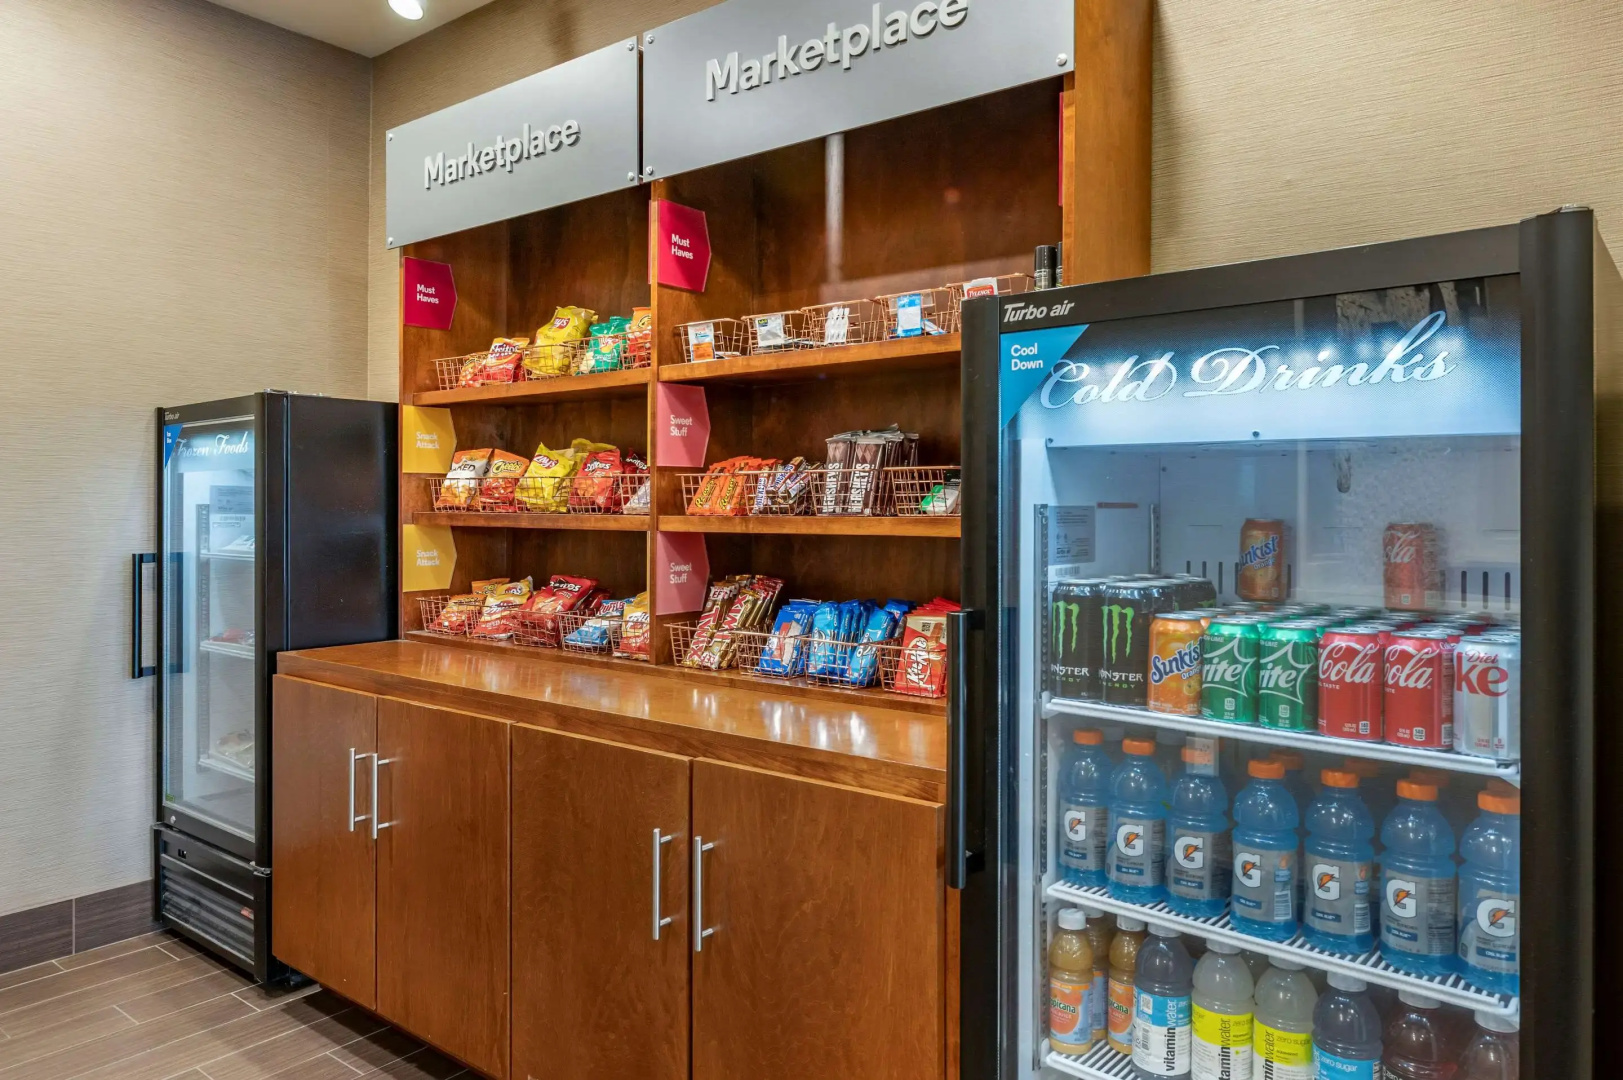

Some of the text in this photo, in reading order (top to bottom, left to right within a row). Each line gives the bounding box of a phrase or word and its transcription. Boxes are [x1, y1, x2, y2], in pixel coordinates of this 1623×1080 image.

[706, 0, 968, 102] Marketplace
[424, 119, 581, 191] Marketplace
[671, 234, 690, 248] Must
[671, 245, 693, 260] Haves
[416, 283, 436, 295] Must
[416, 293, 439, 305] Haves
[1003, 300, 1075, 323] Turbo air
[1010, 344, 1039, 358] Cool
[1010, 358, 1044, 372] Down
[1040, 310, 1459, 410] Cold Drinks
[670, 415, 693, 427] Sweet
[416, 431, 438, 441] Snack
[670, 426, 688, 437] Stuff
[174, 431, 249, 458] Frozen Foods
[416, 440, 440, 449] Attack
[416, 550, 438, 558] Snack
[416, 557, 440, 566] Attack
[670, 562, 692, 573] Sweet
[670, 573, 687, 584] Stuff
[1319, 641, 1379, 684] Cola
[1465, 650, 1499, 664] Diet
[1456, 652, 1509, 697] ke
[1064, 811, 1086, 841] G
[1117, 825, 1144, 857] G
[1174, 836, 1204, 868] G
[1235, 852, 1261, 888] G
[1312, 864, 1340, 900] G
[1386, 879, 1416, 918] G
[1477, 898, 1515, 937] G
[1164, 999, 1176, 1071] vitaminwater
[1321, 1056, 1358, 1073] zero sugar
